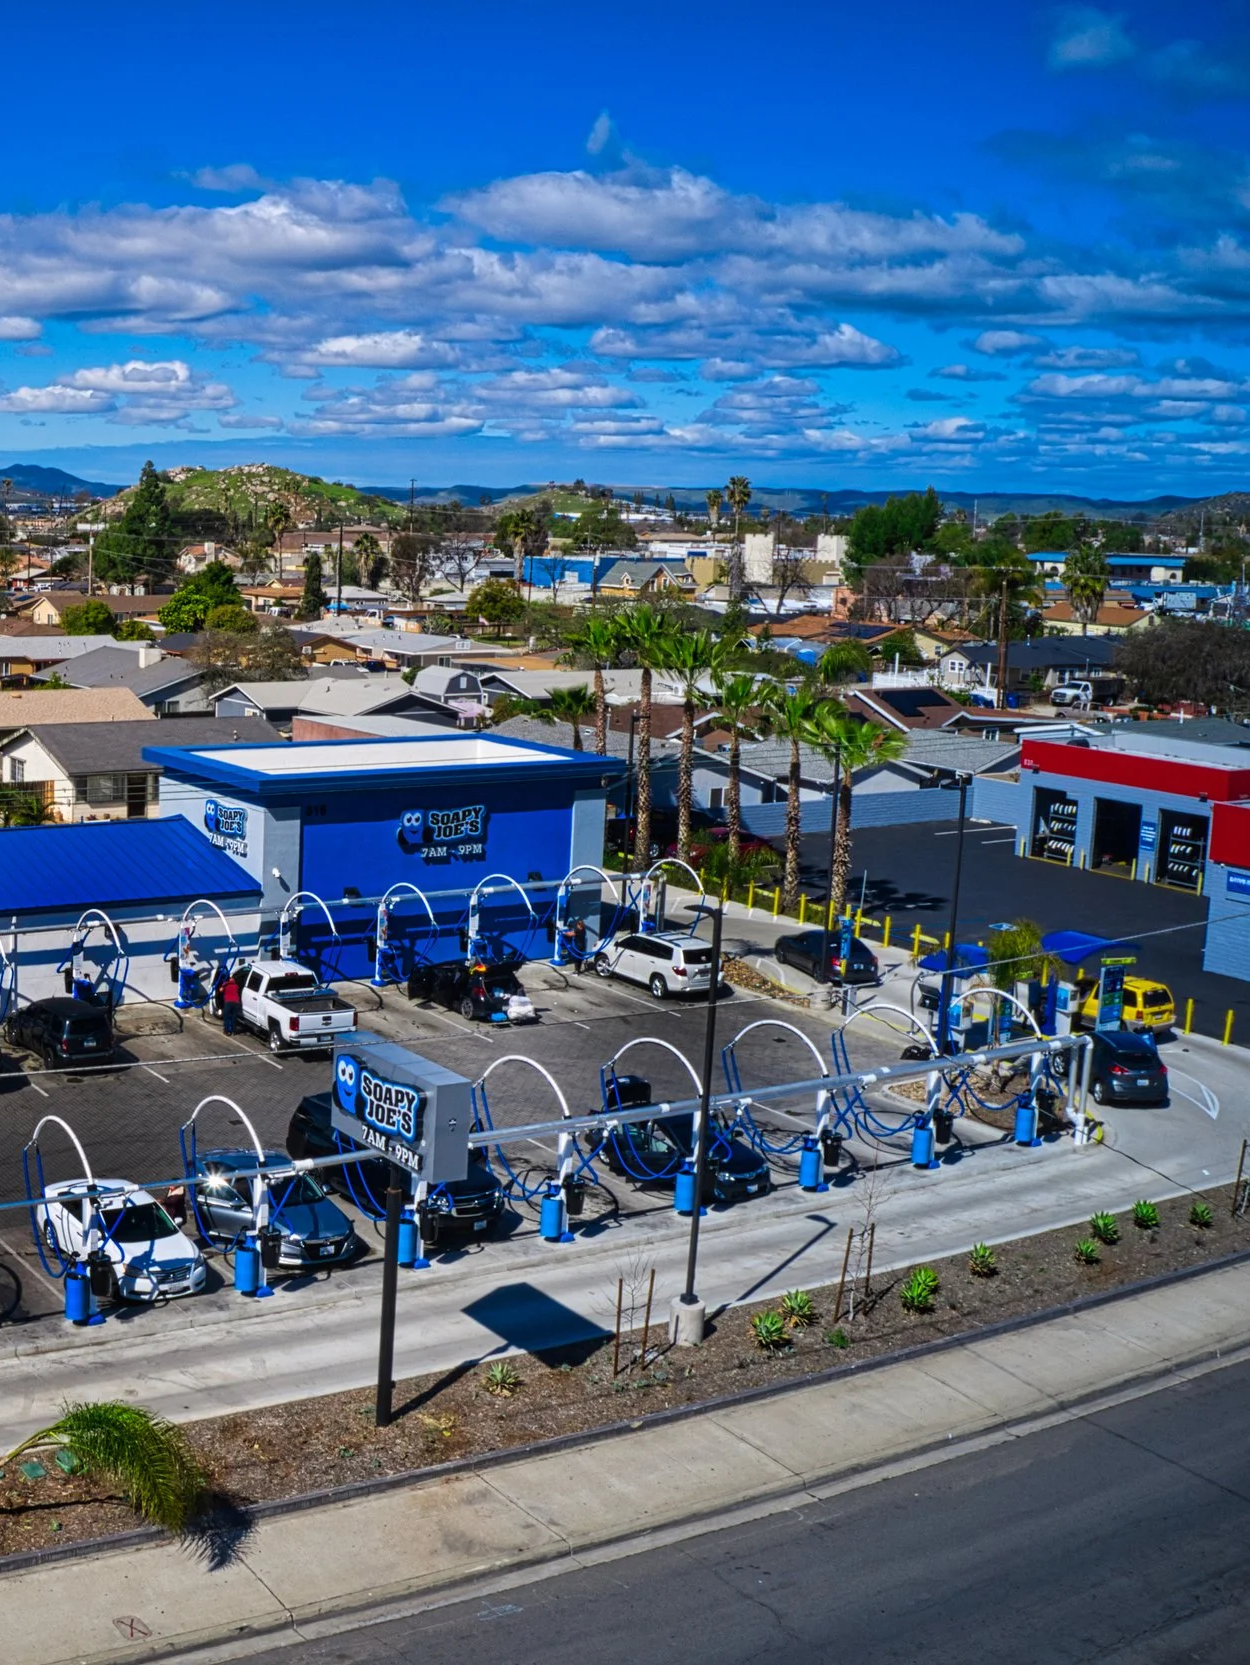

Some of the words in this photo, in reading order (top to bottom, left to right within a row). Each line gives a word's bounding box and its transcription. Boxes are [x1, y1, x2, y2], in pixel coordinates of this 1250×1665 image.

[218, 806, 243, 821] SOAPY
[431, 807, 482, 826] SOAPY
[221, 819, 243, 833] JOE'S
[435, 820, 479, 838] JOE'S
[209, 833, 224, 848] 7AM
[228, 840, 245, 854] 9PM
[421, 847, 447, 857] 7AM
[458, 844, 482, 855] 9PM
[362, 1074, 416, 1113] SOAPY
[367, 1100, 412, 1135] JOE'S
[362, 1125, 386, 1151] 7AM
[395, 1144, 419, 1170] 9PM
